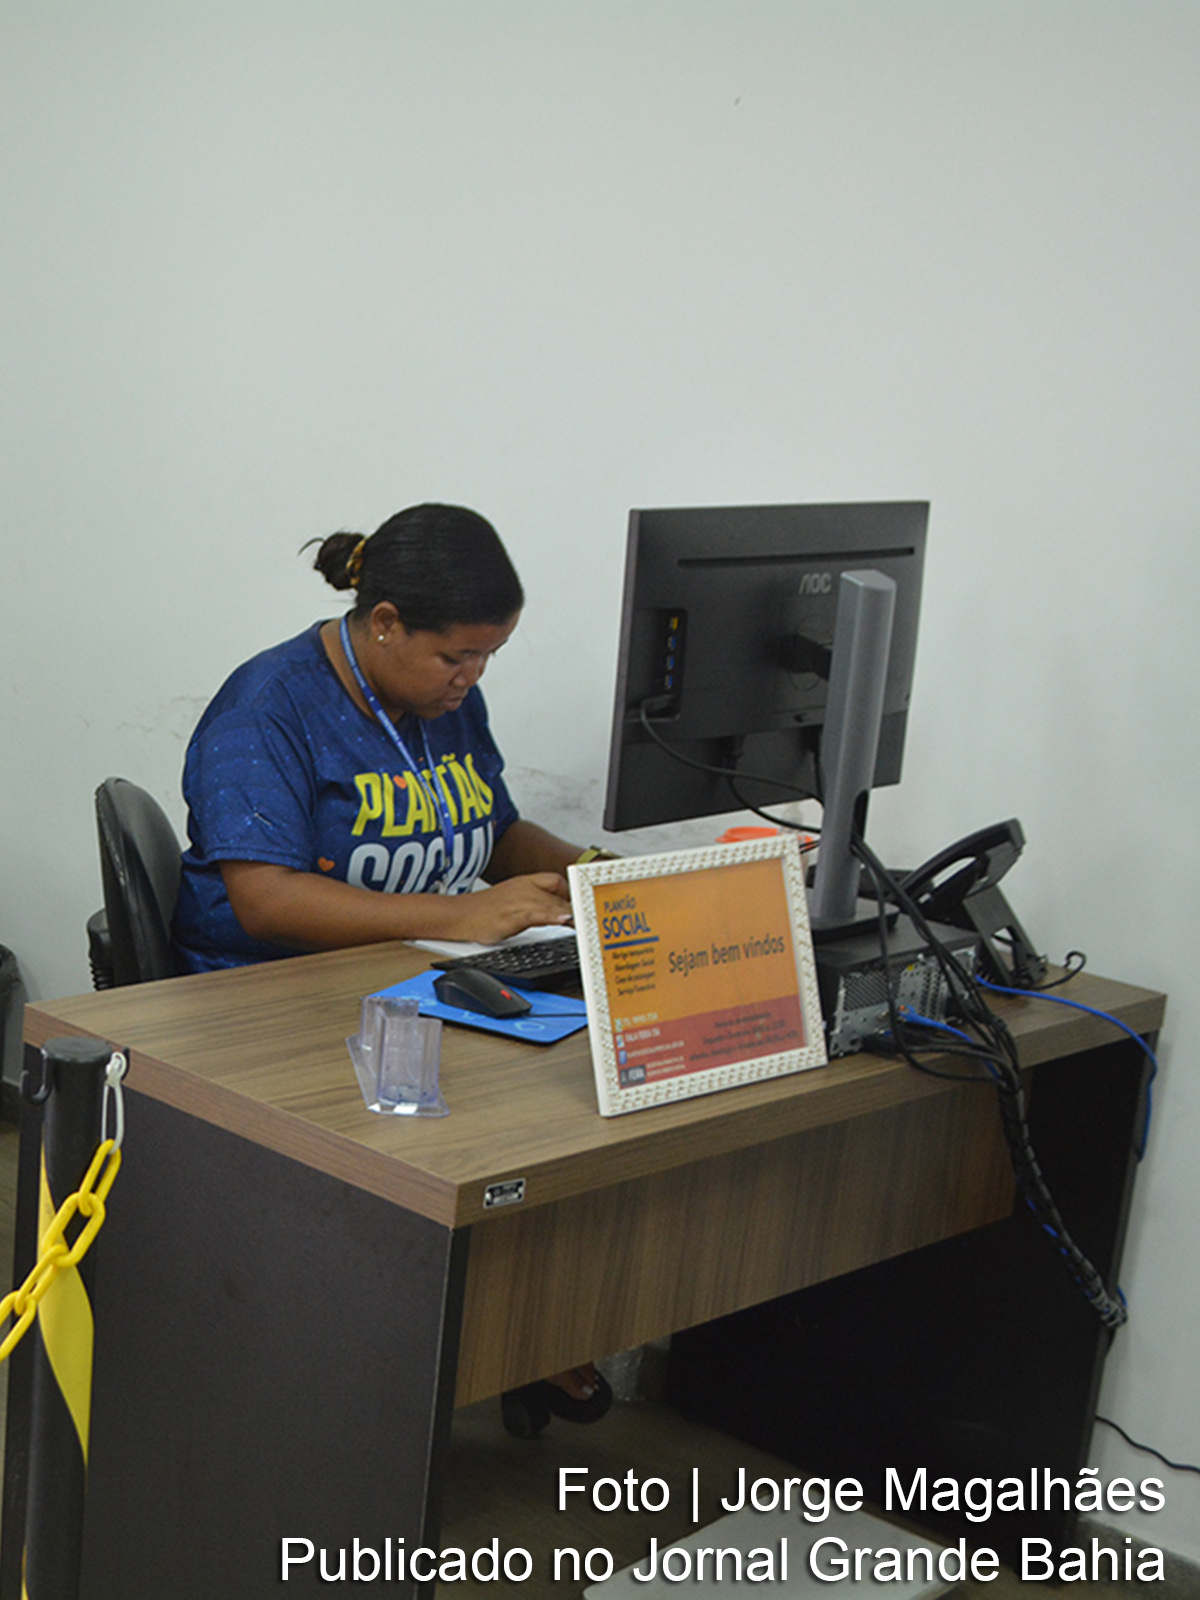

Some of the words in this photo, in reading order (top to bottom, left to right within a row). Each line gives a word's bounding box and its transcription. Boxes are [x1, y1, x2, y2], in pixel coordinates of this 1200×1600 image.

[798, 572, 832, 595] AOC
[604, 895, 636, 913] PLANTÃO
[603, 912, 651, 939] SOCIAL
[668, 948, 709, 977] Sejam
[711, 942, 741, 965] bem
[742, 933, 785, 959] vindos
